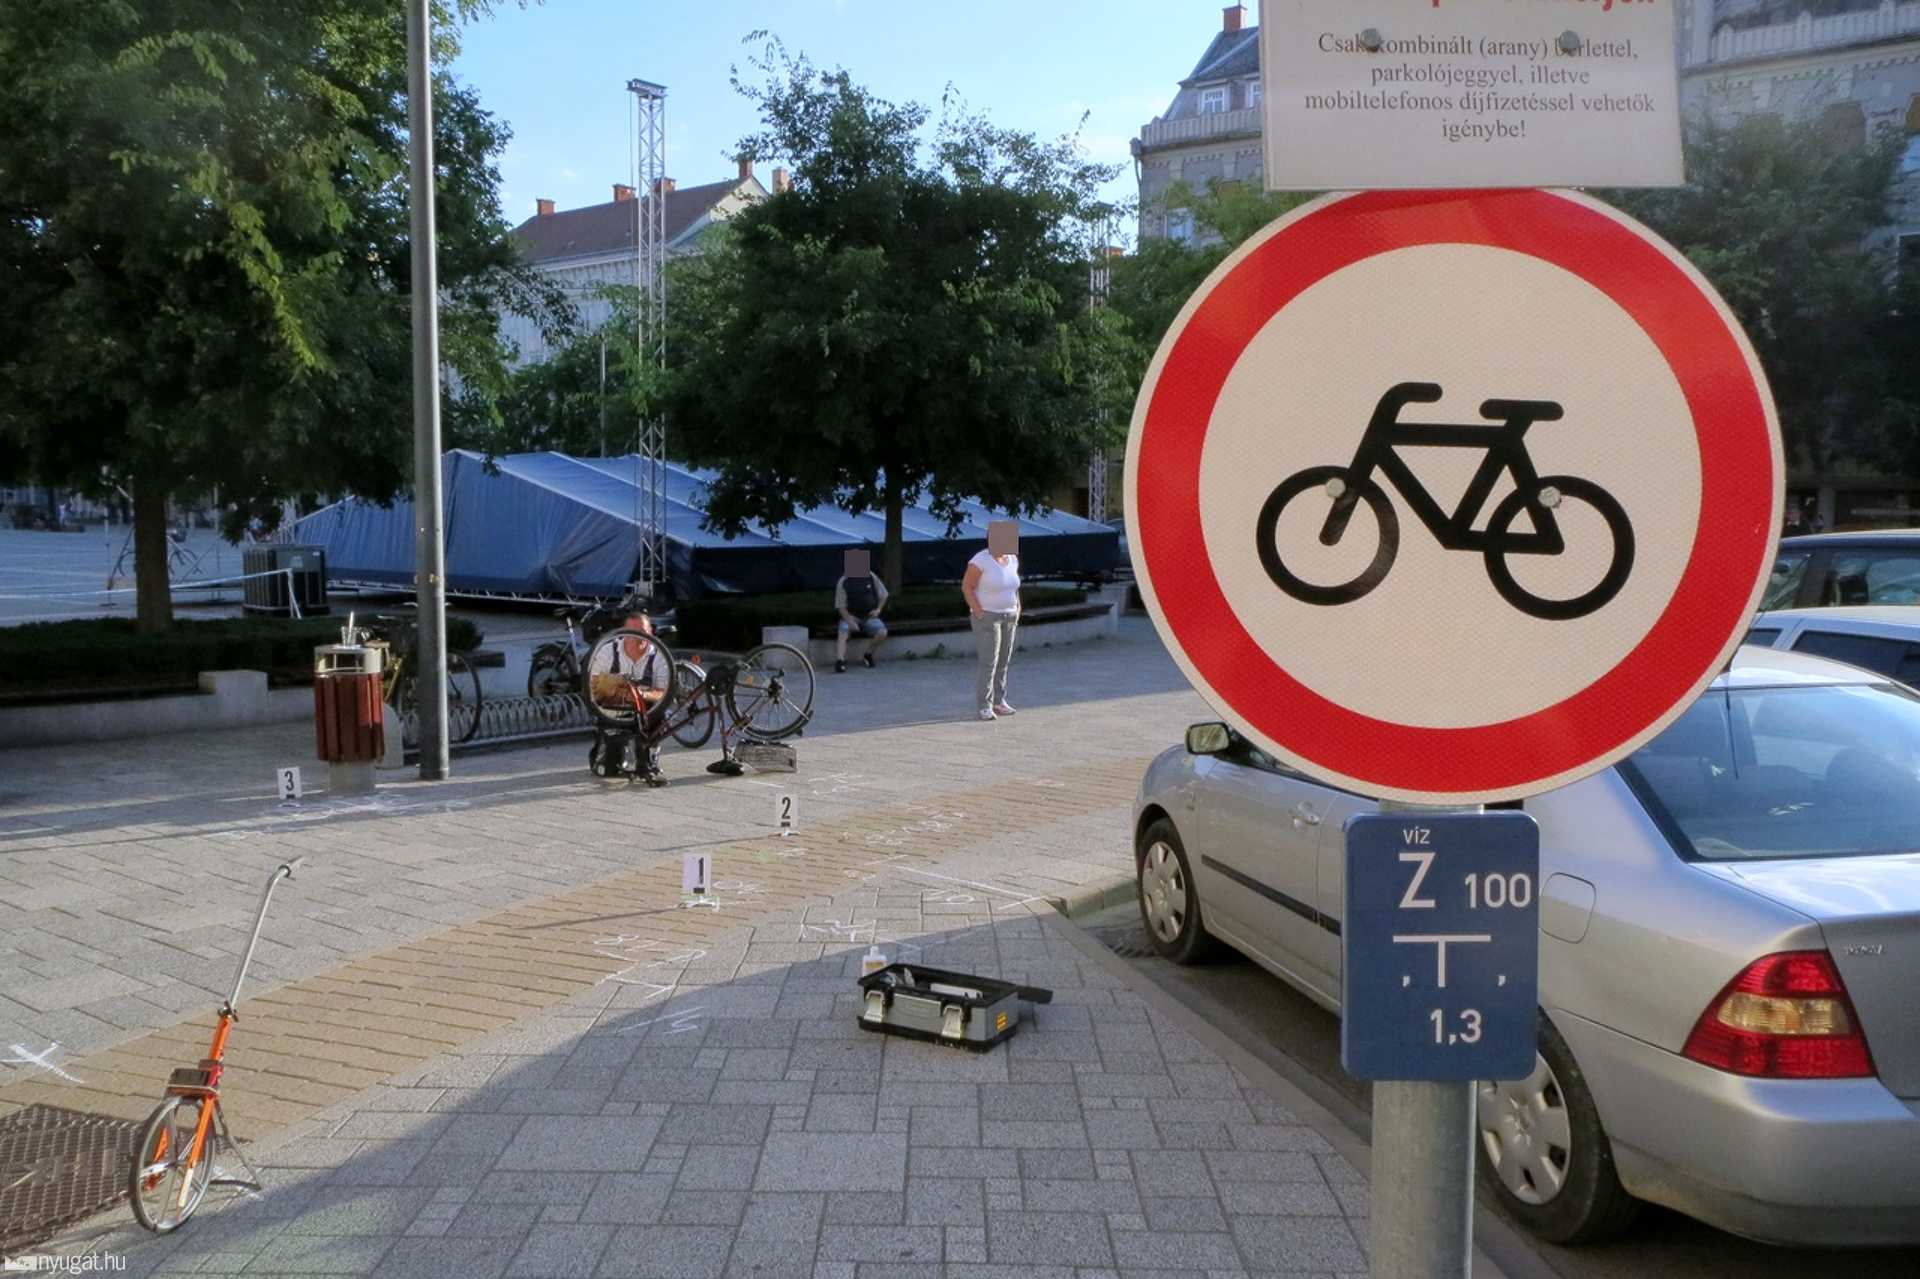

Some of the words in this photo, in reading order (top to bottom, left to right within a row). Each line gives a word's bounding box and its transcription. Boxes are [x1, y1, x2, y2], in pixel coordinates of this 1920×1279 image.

[1479, 37, 1549, 60] (arany)
[1371, 63, 1523, 87] parkolójeggyel,
[1530, 65, 1590, 84] illetve
[1305, 90, 1453, 110] mobiltelefonos
[1459, 91, 1575, 115] díjfizetéssel
[1442, 119, 1526, 142] igénybe!
[284, 770, 295, 791] 3
[781, 796, 791, 819] 2
[698, 857, 704, 884] 1
[1399, 852, 1436, 908] Z
[1465, 873, 1531, 909] 100
[1430, 1008, 1482, 1045] 1,3
